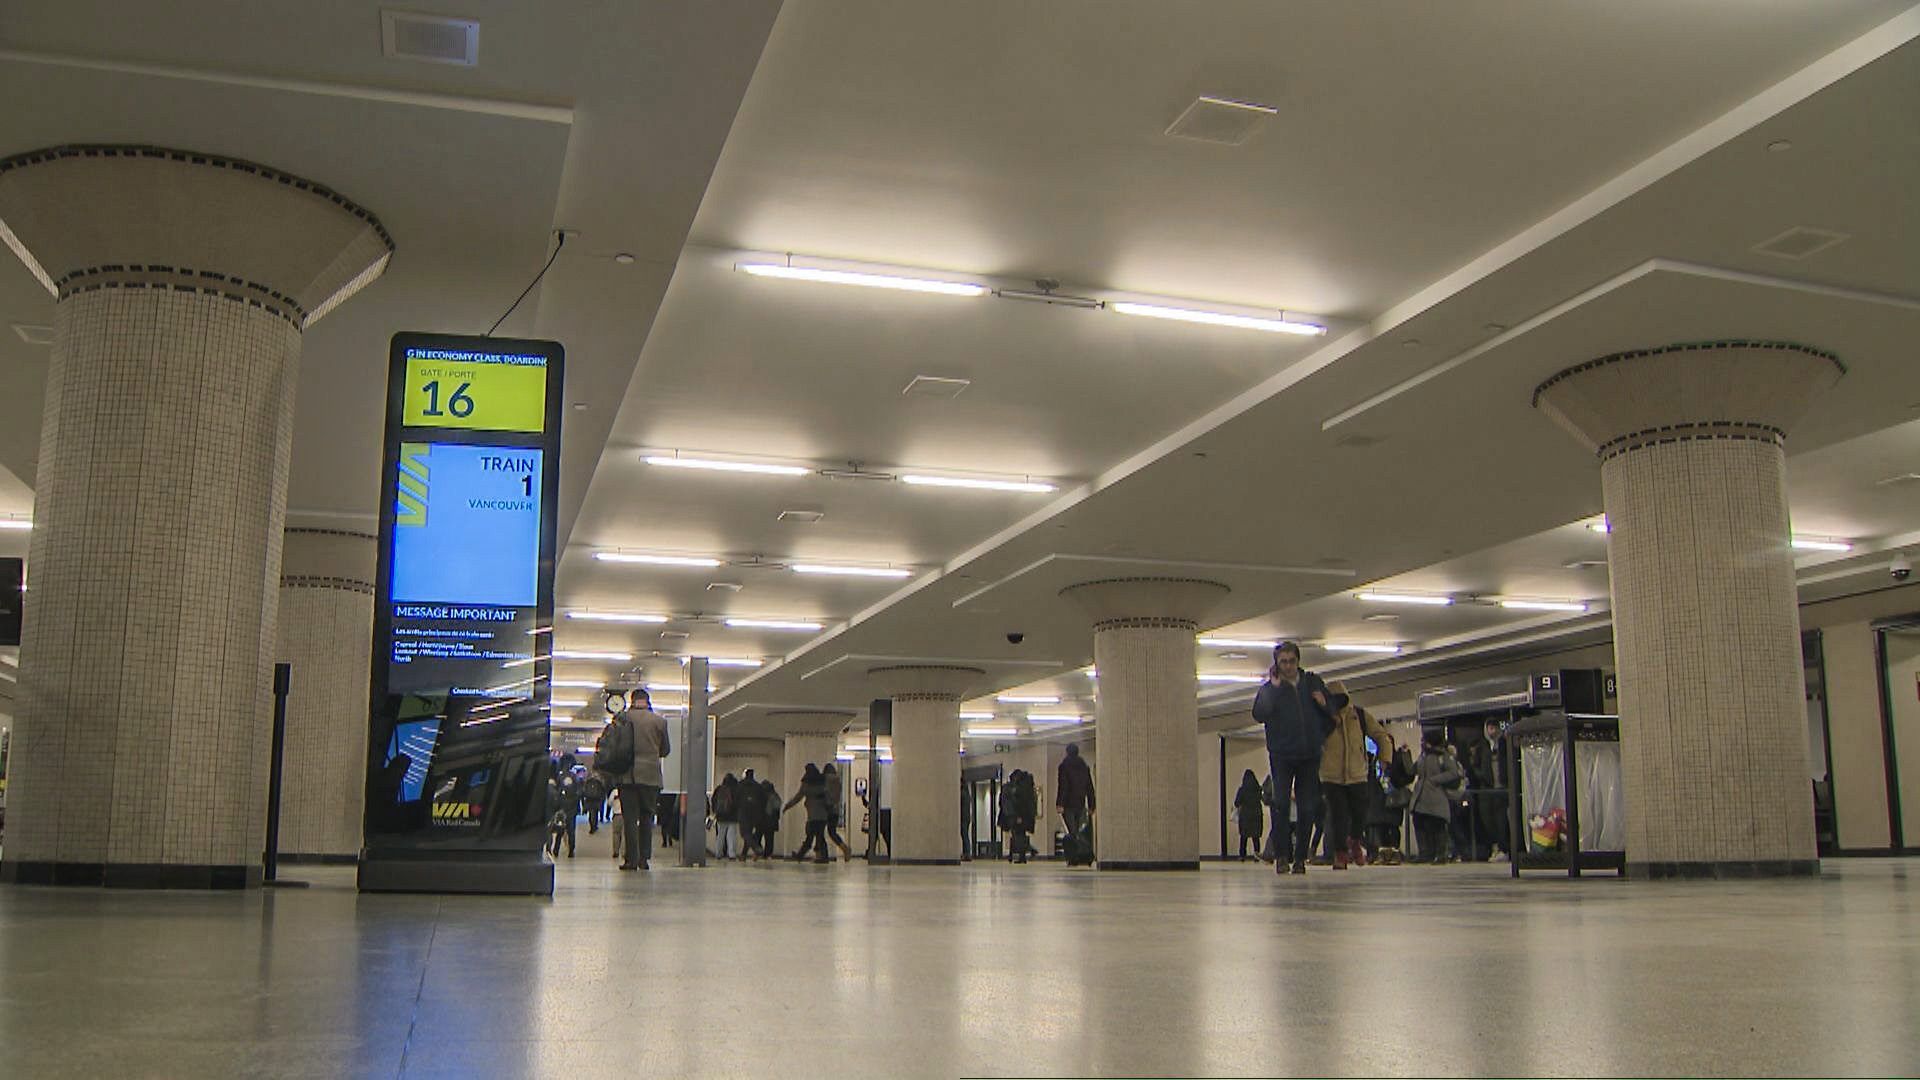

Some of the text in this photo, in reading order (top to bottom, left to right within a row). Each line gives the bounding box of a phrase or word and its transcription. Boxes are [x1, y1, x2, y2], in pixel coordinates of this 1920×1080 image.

[416, 350, 426, 359] IN
[427, 351, 474, 361] ECONOMY
[420, 369, 442, 377] GATE
[449, 370, 476, 379] PORTE
[422, 380, 475, 418] 16
[481, 456, 534, 473] TRAIN
[521, 474, 532, 497] 1
[468, 499, 533, 511] VANCOUVER
[396, 606, 517, 621] MESSAGE IMPORTANT
[1542, 676, 1551, 688] 9
[432, 803, 470, 818] VIA
